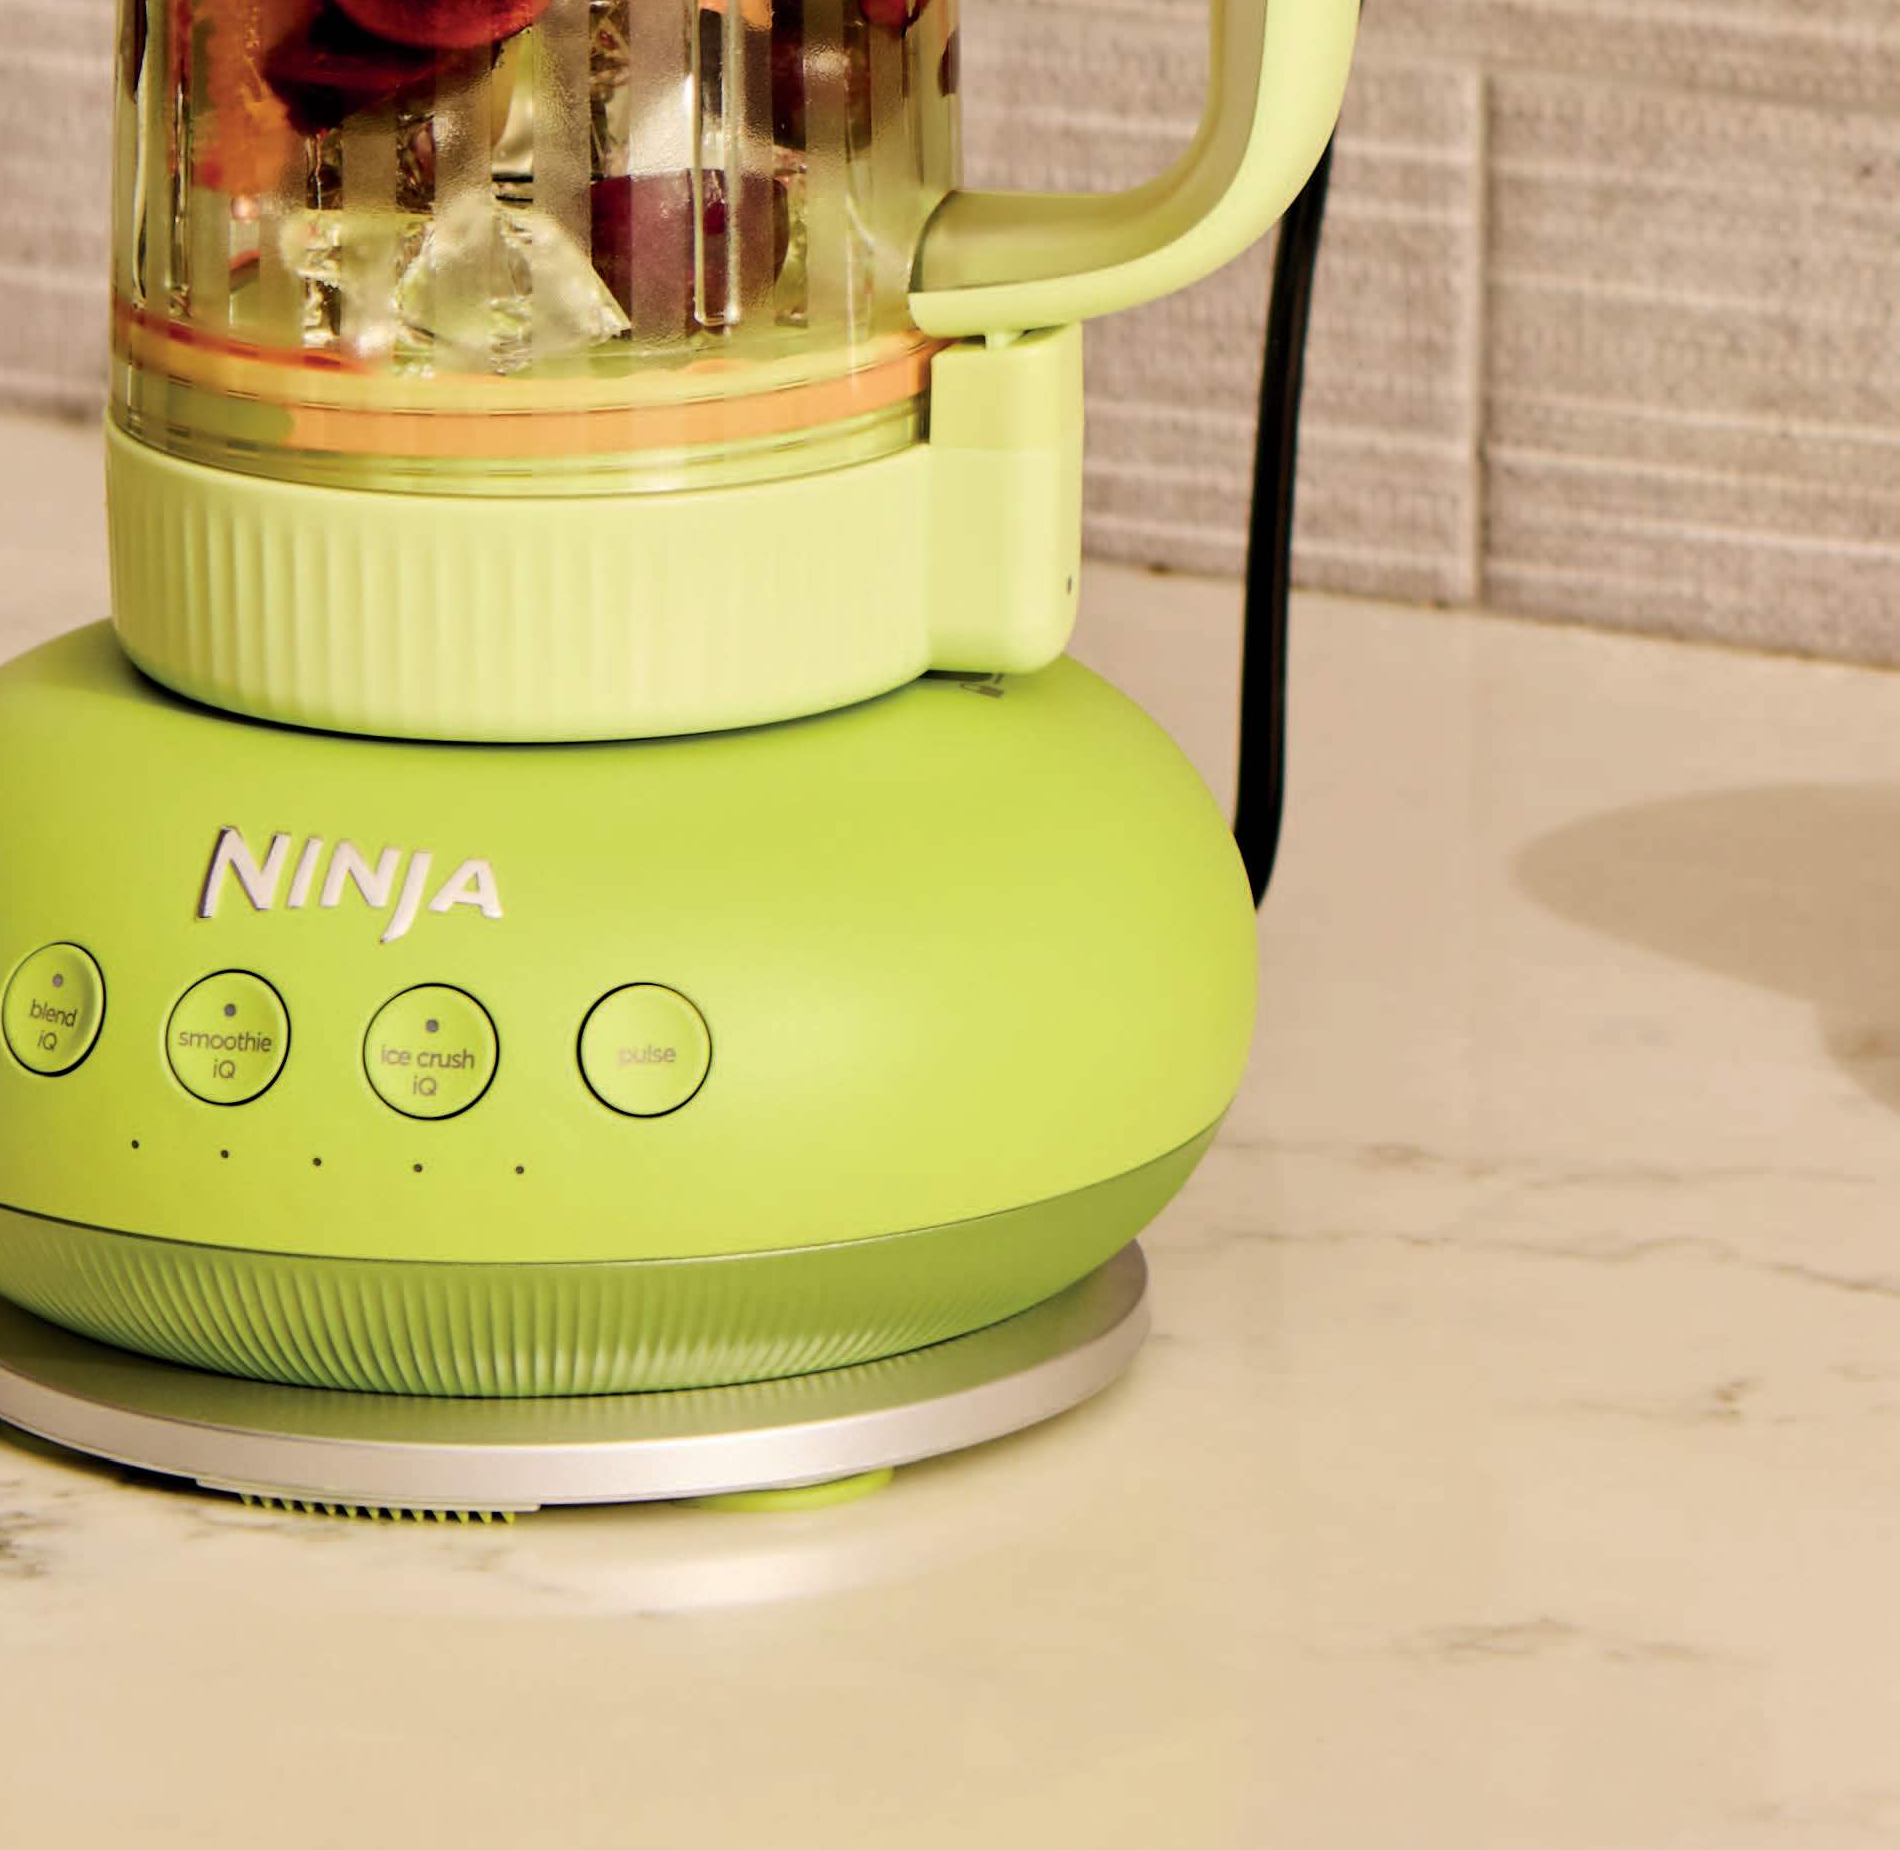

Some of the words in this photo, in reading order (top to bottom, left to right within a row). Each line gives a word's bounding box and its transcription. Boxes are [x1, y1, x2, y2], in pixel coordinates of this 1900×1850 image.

[196, 825, 503, 944] NINJA
[30, 999, 78, 1027] blend
[37, 1030, 58, 1053] iQ
[178, 1030, 272, 1052] smoothie
[380, 1045, 412, 1066] ice
[416, 1047, 475, 1070] crush
[617, 1044, 677, 1068] pulse
[212, 1059, 236, 1080] iQ
[412, 1075, 437, 1097] iQ
